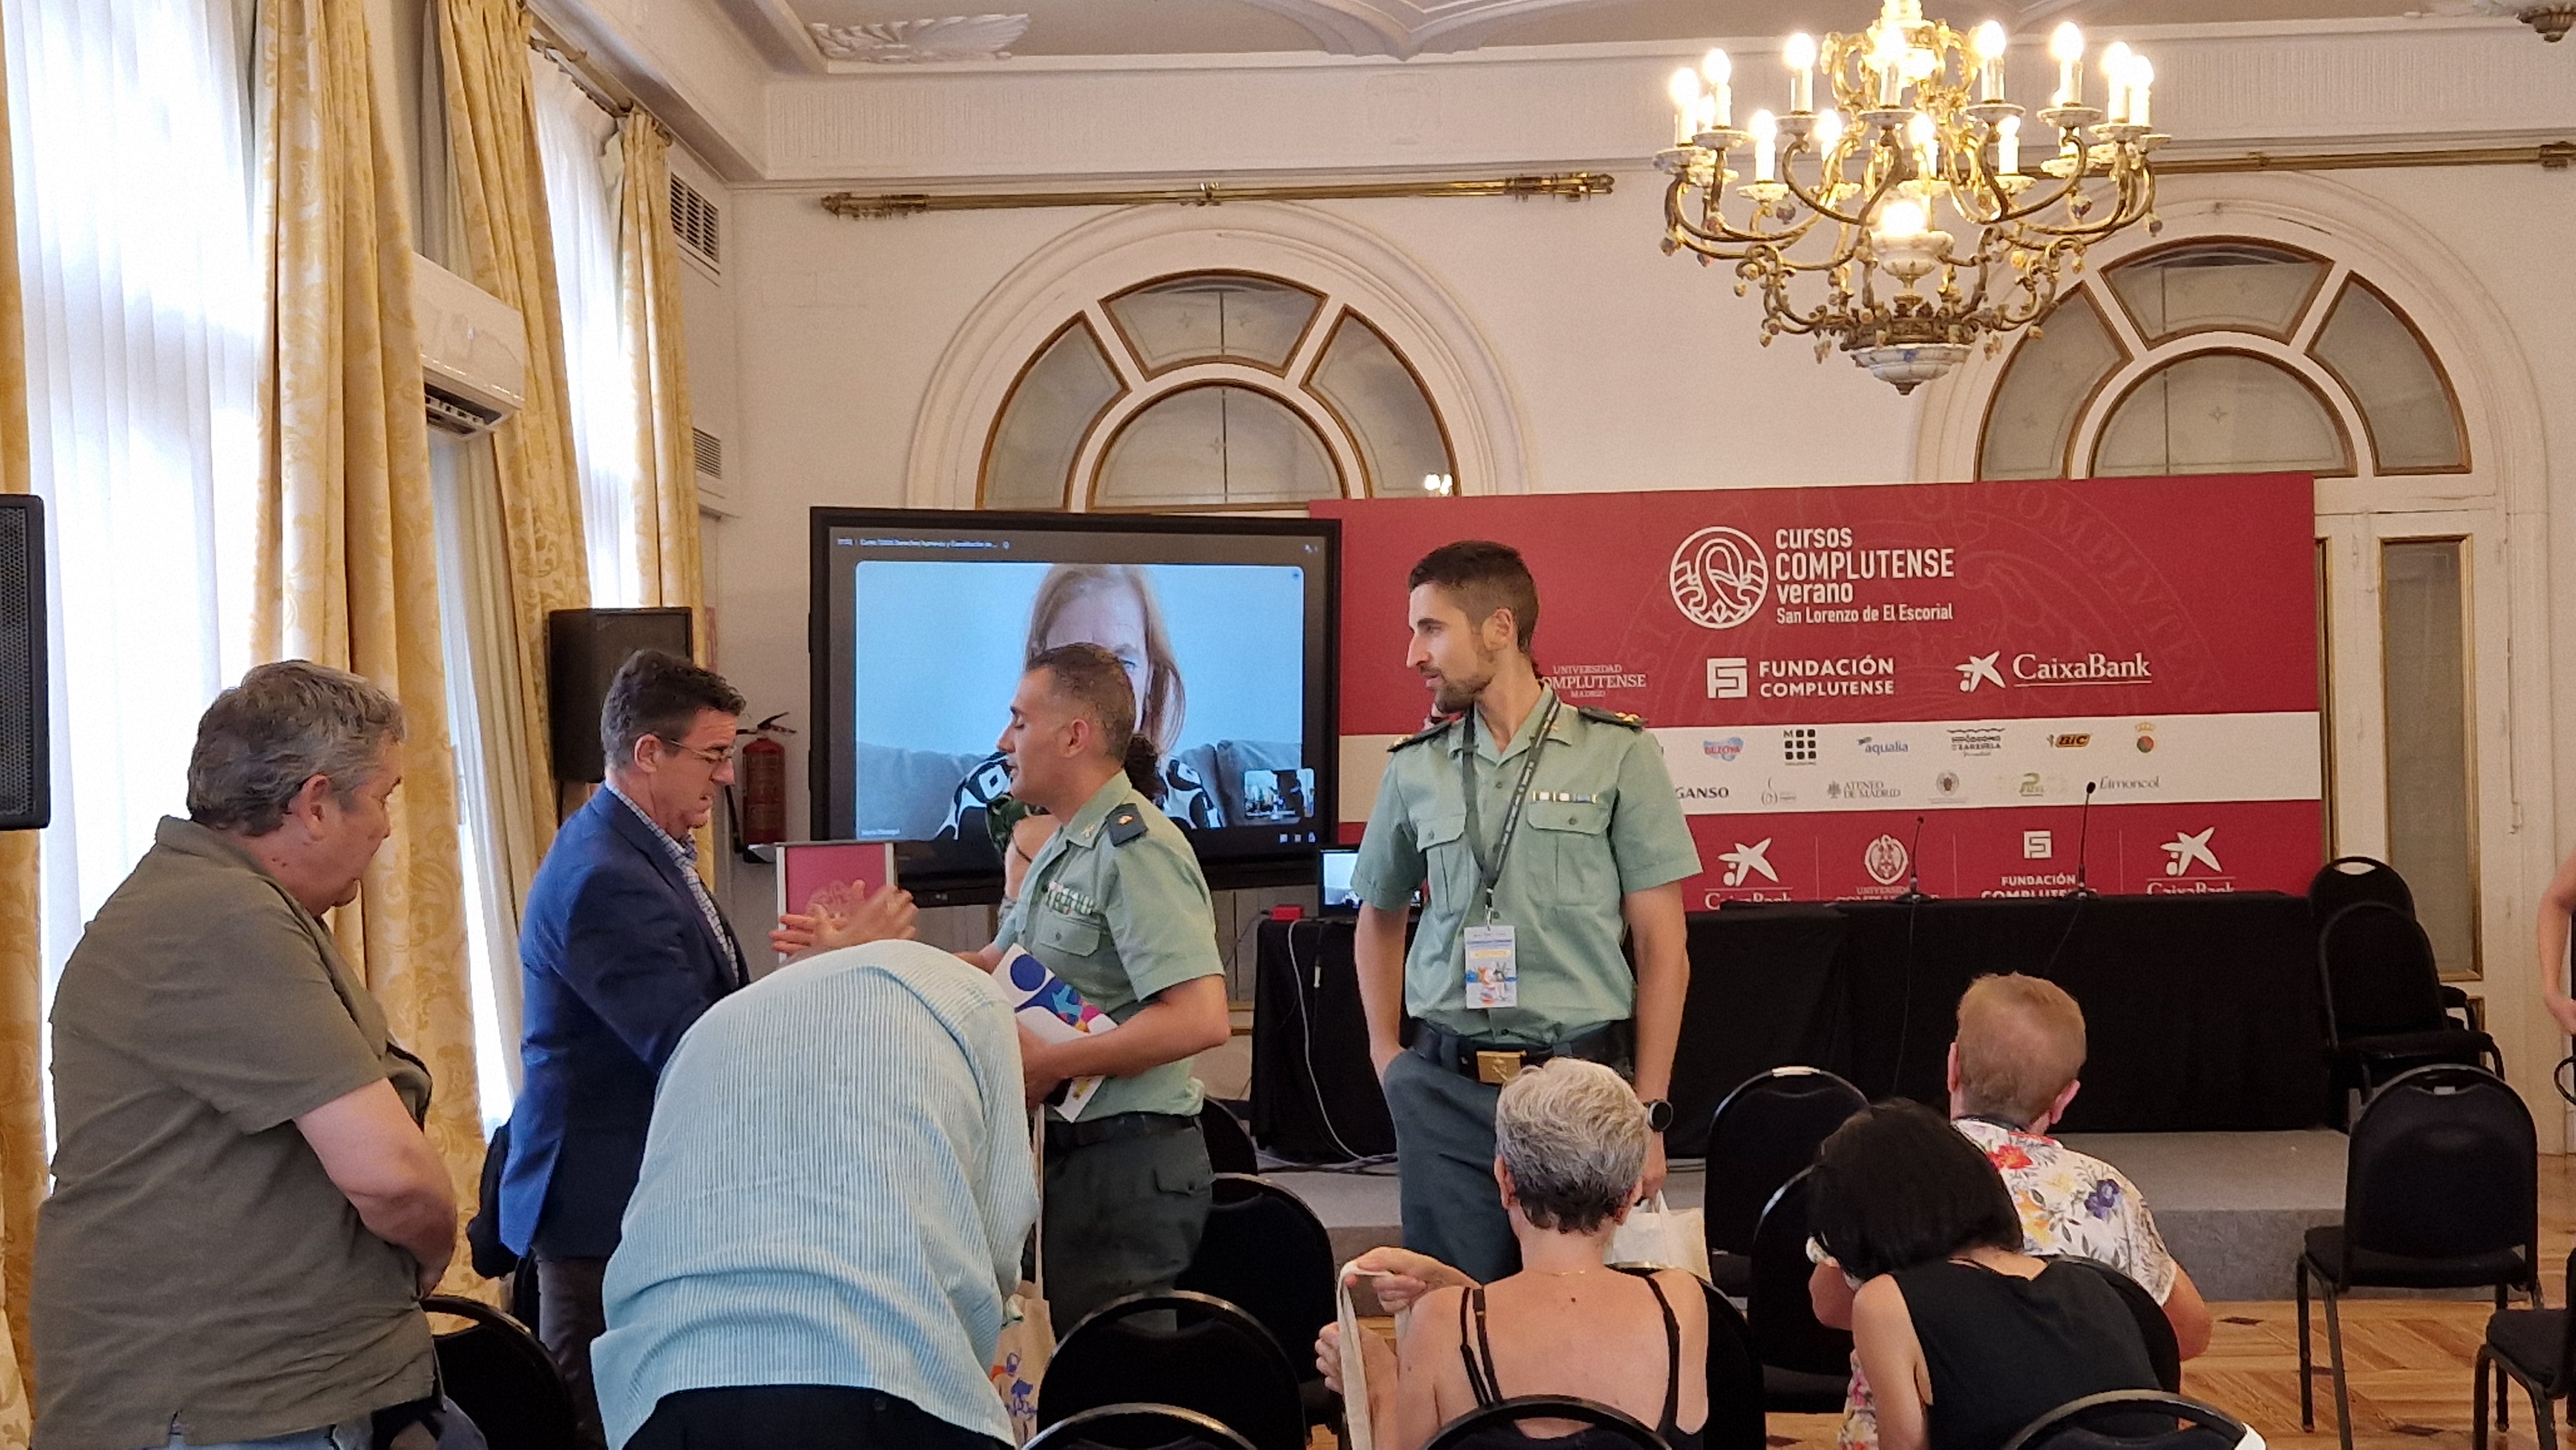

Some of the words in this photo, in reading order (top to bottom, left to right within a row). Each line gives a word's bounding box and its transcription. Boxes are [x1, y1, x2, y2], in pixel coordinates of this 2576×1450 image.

[1776, 527, 1853, 549] cursos
[1776, 549, 1954, 581] COMPLUTENSE
[1776, 583, 1853, 604] verano
[1776, 608, 1802, 625] San
[1806, 607, 1859, 623] Lorenzo
[1862, 605, 1879, 621] de
[1883, 604, 1896, 621] El
[1899, 599, 1953, 620] Escorial
[1553, 664, 1622, 674] UNIVERSIDAD
[1759, 654, 1894, 677] FUNDACIÓN
[2012, 652, 2152, 681] CaixaBank
[1544, 673, 1646, 689] OMPLUTENSE
[1570, 690, 1606, 699] MADRID
[1760, 680, 1894, 698] COMPLUTENSE
[1865, 741, 1908, 755] aqualia
[2059, 735, 2087, 746] BIC
[1844, 780, 1884, 790] ATENEO
[1844, 789, 1855, 798] DE
[1859, 787, 1901, 798] MADRID
[1676, 787, 1729, 799] GANSO
[2001, 872, 2076, 887] FUNDACIÓN
